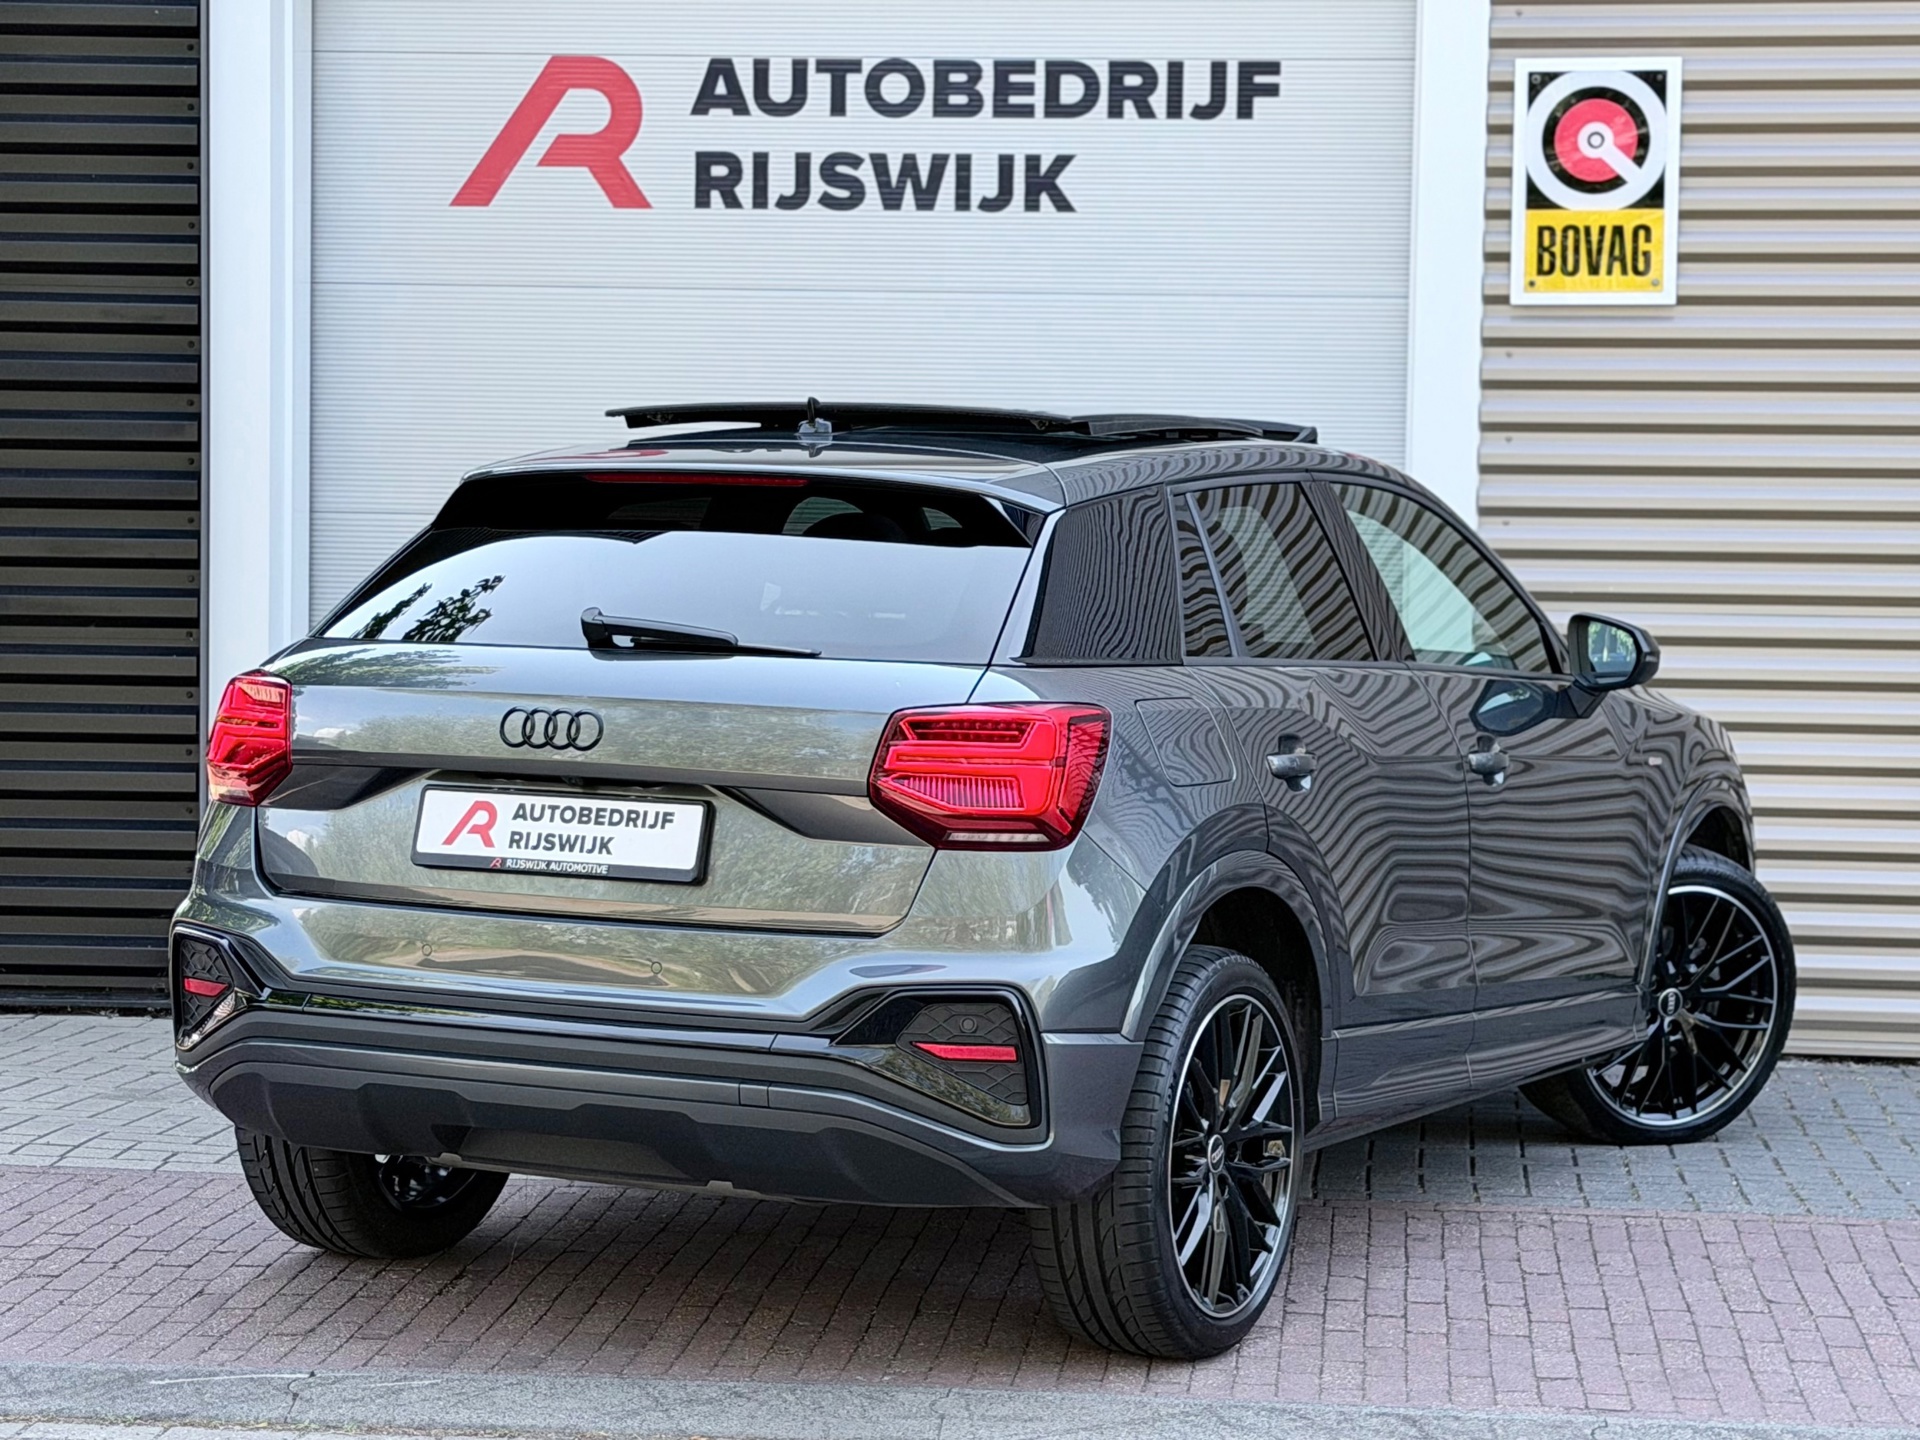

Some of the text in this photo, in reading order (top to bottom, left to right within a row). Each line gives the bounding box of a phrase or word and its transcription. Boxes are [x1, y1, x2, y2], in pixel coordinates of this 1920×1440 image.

[690, 58, 1281, 120] AUTOBEDRIJF
[695, 151, 1077, 212] RIJSWIJK
[1536, 224, 1652, 276] BOVAG
[512, 803, 675, 829] AUTOBEDRIJF
[508, 831, 615, 855] RIJSWIJK
[506, 859, 547, 870] RIJSWIJK
[549, 862, 608, 874] AUTOMOTIVE
